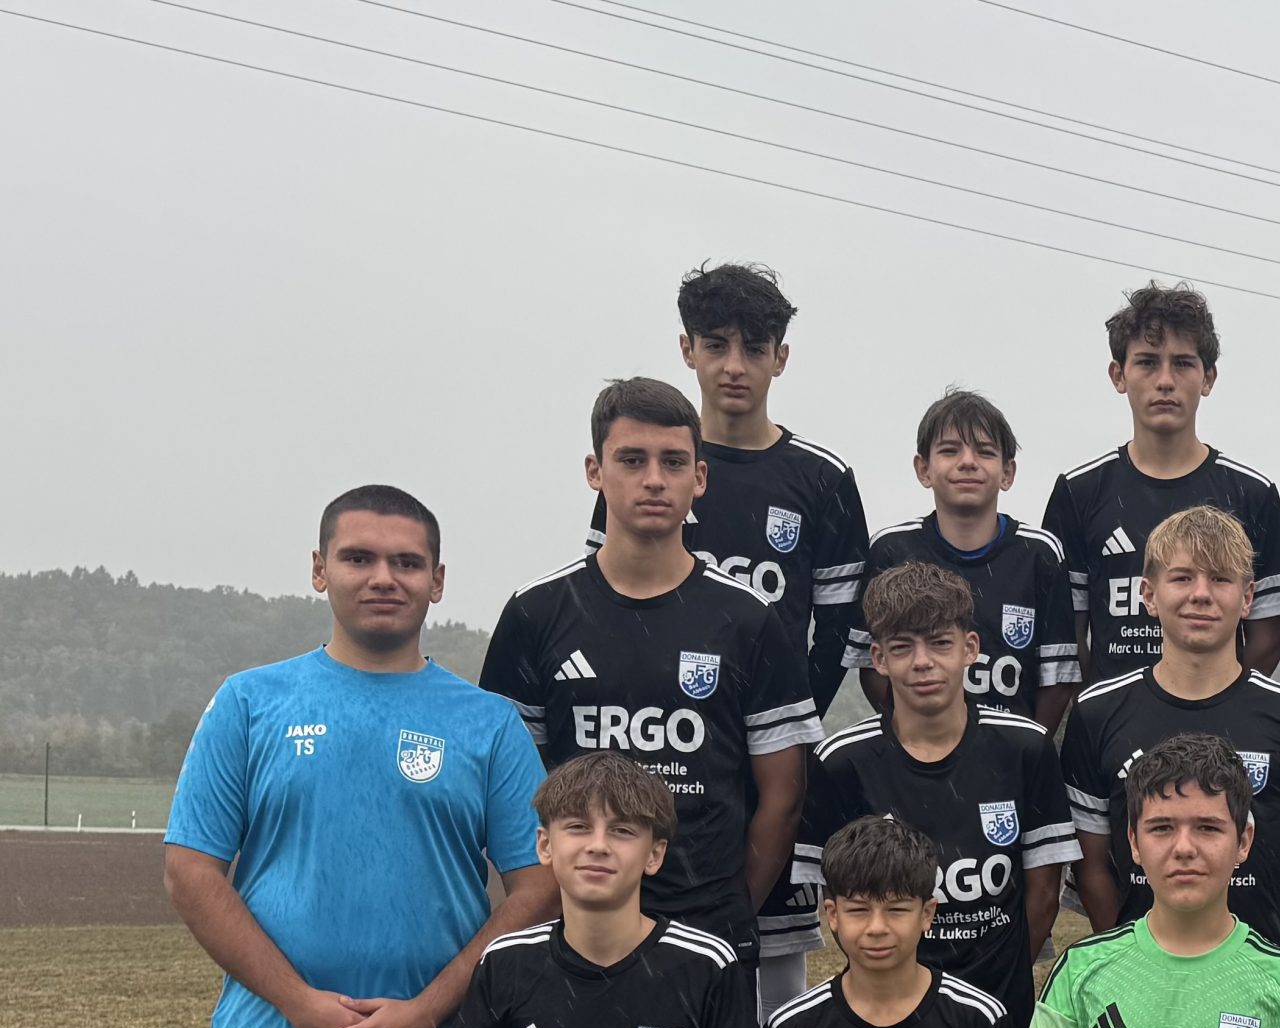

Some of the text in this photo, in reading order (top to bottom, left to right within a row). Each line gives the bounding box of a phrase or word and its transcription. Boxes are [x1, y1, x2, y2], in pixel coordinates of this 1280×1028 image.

[1109, 642, 1131, 654] Marc
[962, 653, 1022, 696] GO
[285, 724, 327, 738] JAKO
[572, 705, 705, 753] ERGO
[294, 738, 315, 756] TS
[664, 781, 704, 794] orsch
[1227, 873, 1256, 886] rsch
[931, 906, 1001, 925] chäftsstelle
[940, 928, 977, 940] Lukas
